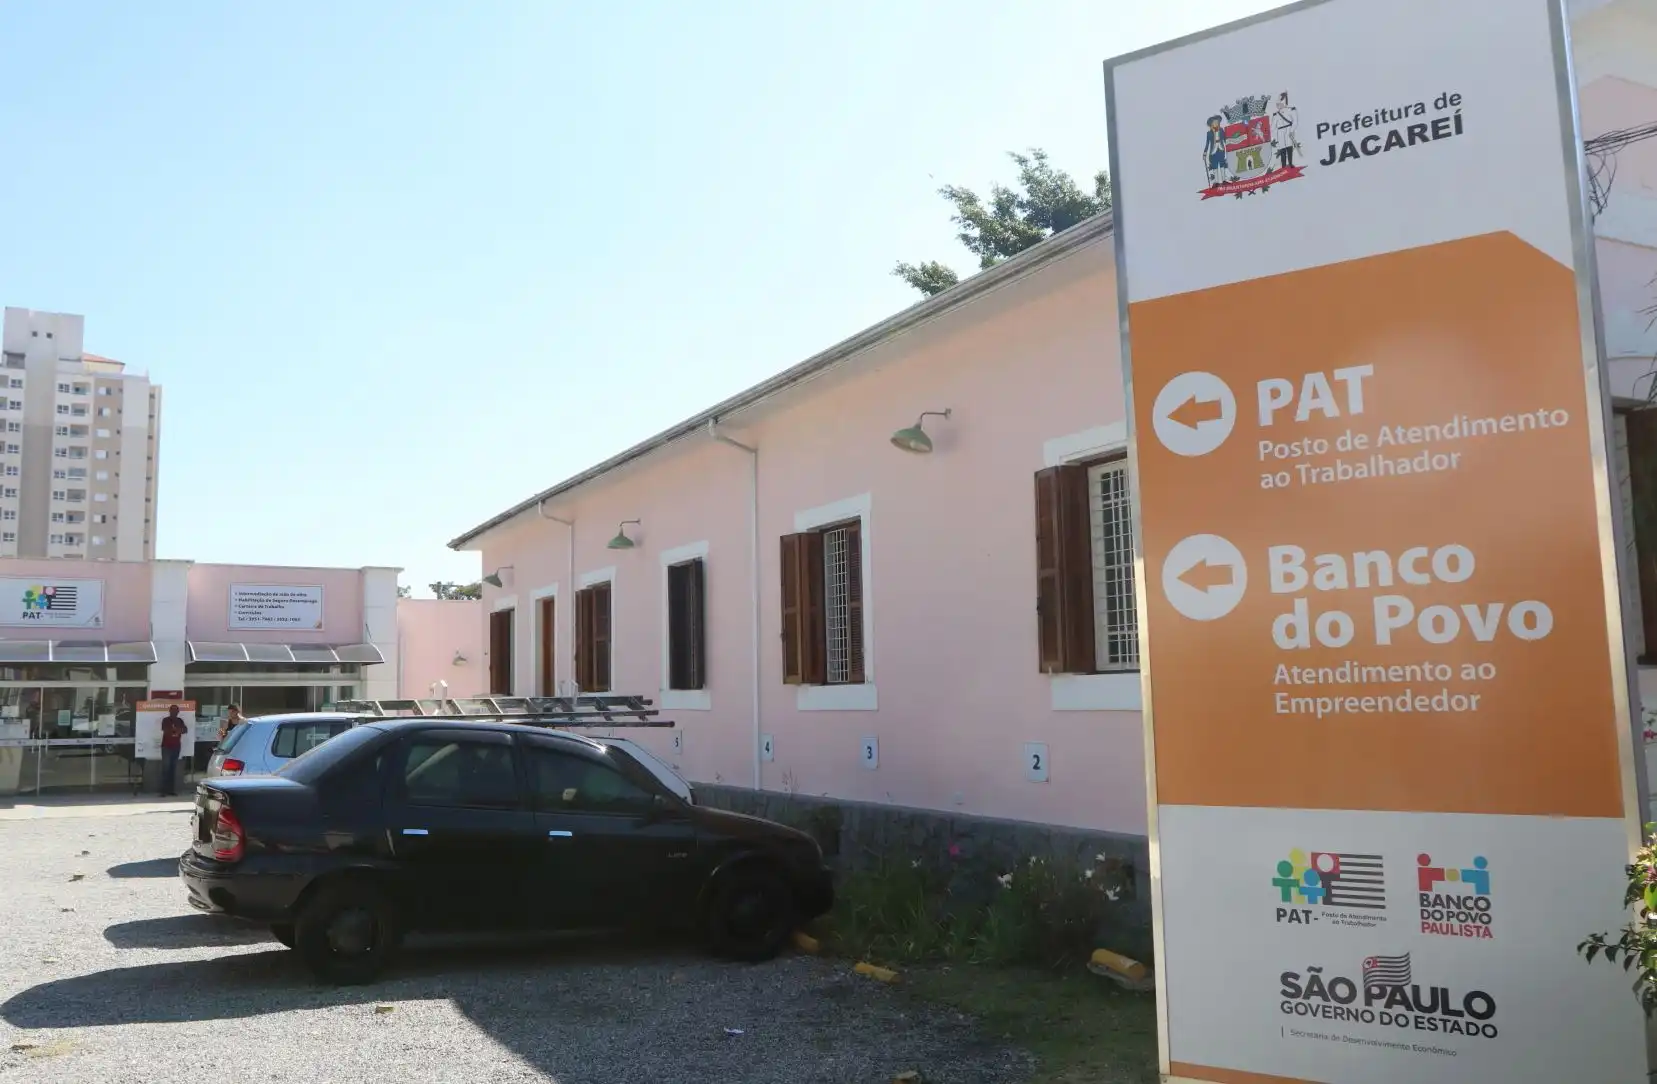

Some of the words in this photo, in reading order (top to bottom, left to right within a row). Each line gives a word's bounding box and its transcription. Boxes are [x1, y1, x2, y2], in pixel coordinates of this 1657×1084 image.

[1316, 101, 1426, 139] Prefeitura
[1433, 91, 1462, 111] de
[1319, 109, 1464, 167] JACAREÍ
[1256, 364, 1374, 426] PAT
[1258, 436, 1329, 461] Posto
[1336, 430, 1369, 451] de
[1376, 406, 1570, 447] Atendimento
[1260, 469, 1291, 489] ao
[1296, 448, 1462, 486] Trabalhador
[1268, 543, 1476, 594] Banco
[1272, 597, 1355, 650] do
[1373, 594, 1554, 645] Povo
[1273, 661, 1452, 686] Atendimento
[1460, 662, 1497, 682] ao
[1275, 689, 1481, 718] Empreendedor
[764, 741, 770, 754] 4
[866, 746, 873, 760] 3
[1032, 754, 1041, 770] 2
[1419, 893, 1492, 912] BANCO
[1420, 909, 1445, 923] DO
[1446, 911, 1492, 925] POVO
[1341, 920, 1377, 928] Trabalhador
[1349, 914, 1387, 922] Atendimento
[1421, 921, 1494, 939] PAULISTA
[1280, 965, 1358, 1005] SÃO
[1364, 984, 1497, 1020] PAULO
[1280, 1000, 1376, 1024] GOVERNO
[1379, 1011, 1410, 1028] DO
[1414, 1015, 1499, 1039] ESTADO
[1290, 1028, 1328, 1041] Secretaria
[1331, 1033, 1340, 1042] de
[1343, 1035, 1411, 1051] Desenvolvimento
[1412, 1044, 1457, 1057] Econômico
